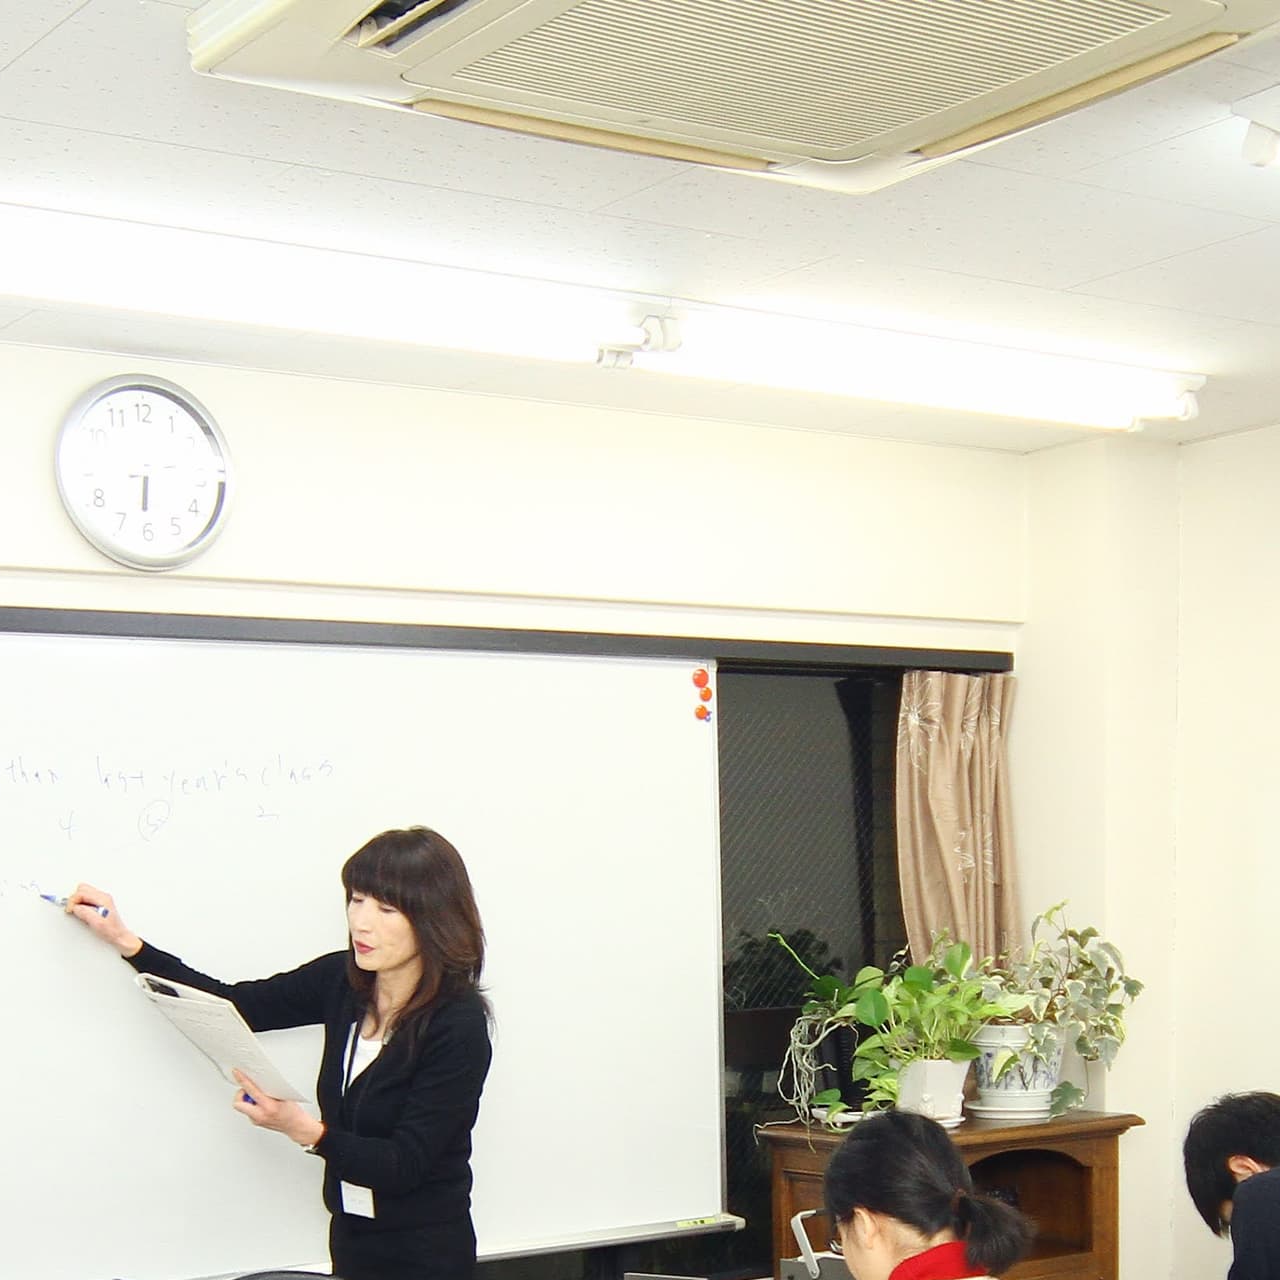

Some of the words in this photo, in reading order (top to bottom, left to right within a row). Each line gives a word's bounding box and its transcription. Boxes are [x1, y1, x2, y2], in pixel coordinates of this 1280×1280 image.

[108, 407, 126, 428] 11
[133, 403, 153, 424] 12
[168, 415, 175, 433] 1
[93, 488, 105, 508] 8
[188, 498, 200, 516] 4
[116, 512, 127, 531] 7
[170, 517, 182, 536] 5
[142, 523, 154, 542] 6
